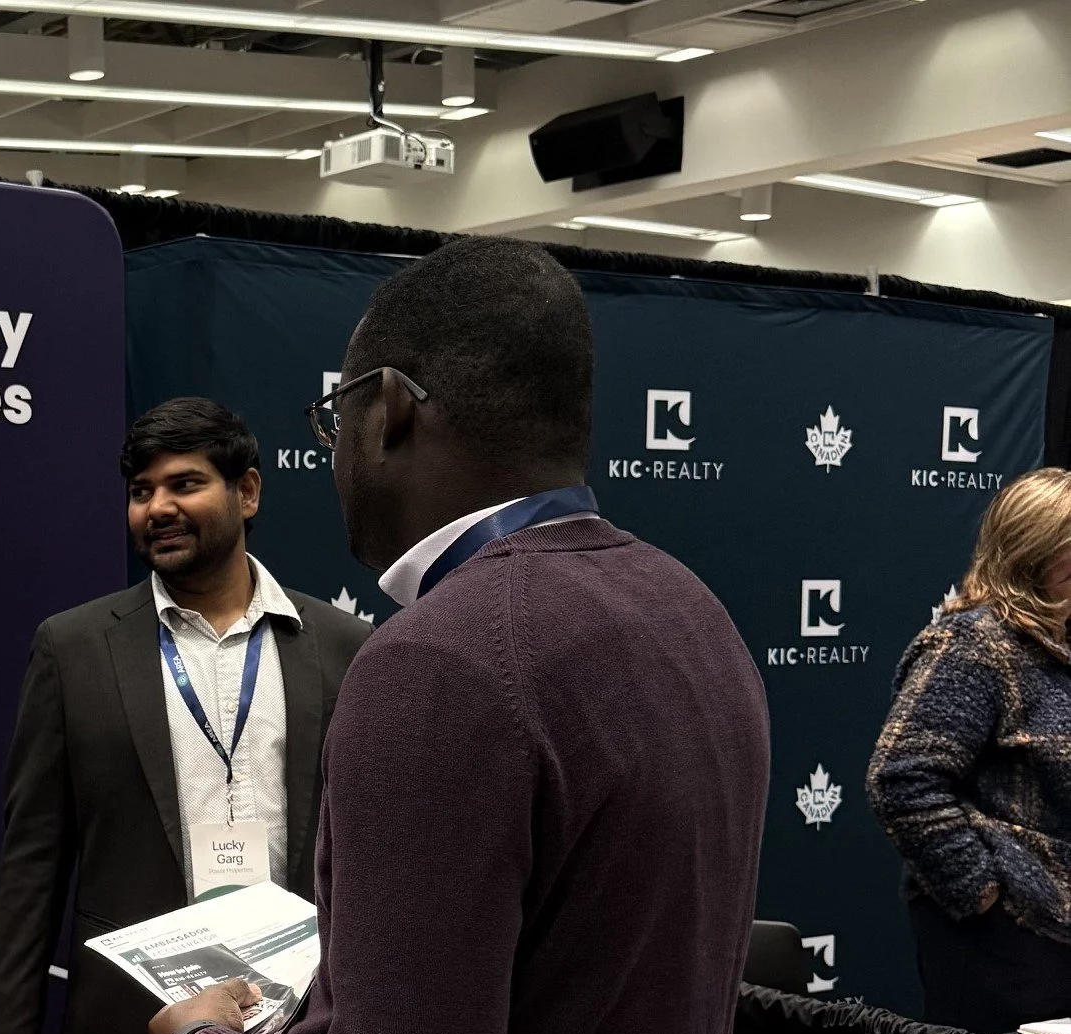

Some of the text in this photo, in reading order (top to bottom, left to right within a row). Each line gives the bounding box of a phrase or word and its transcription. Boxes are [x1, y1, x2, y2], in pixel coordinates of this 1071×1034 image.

[809, 432, 849, 462] CANADIAN
[172, 655, 187, 674] AREA
[798, 789, 838, 819] CANADIAN
[212, 840, 245, 852] Lucky
[216, 854, 244, 866] Garg
[145, 927, 210, 951] AMBASSADOR
